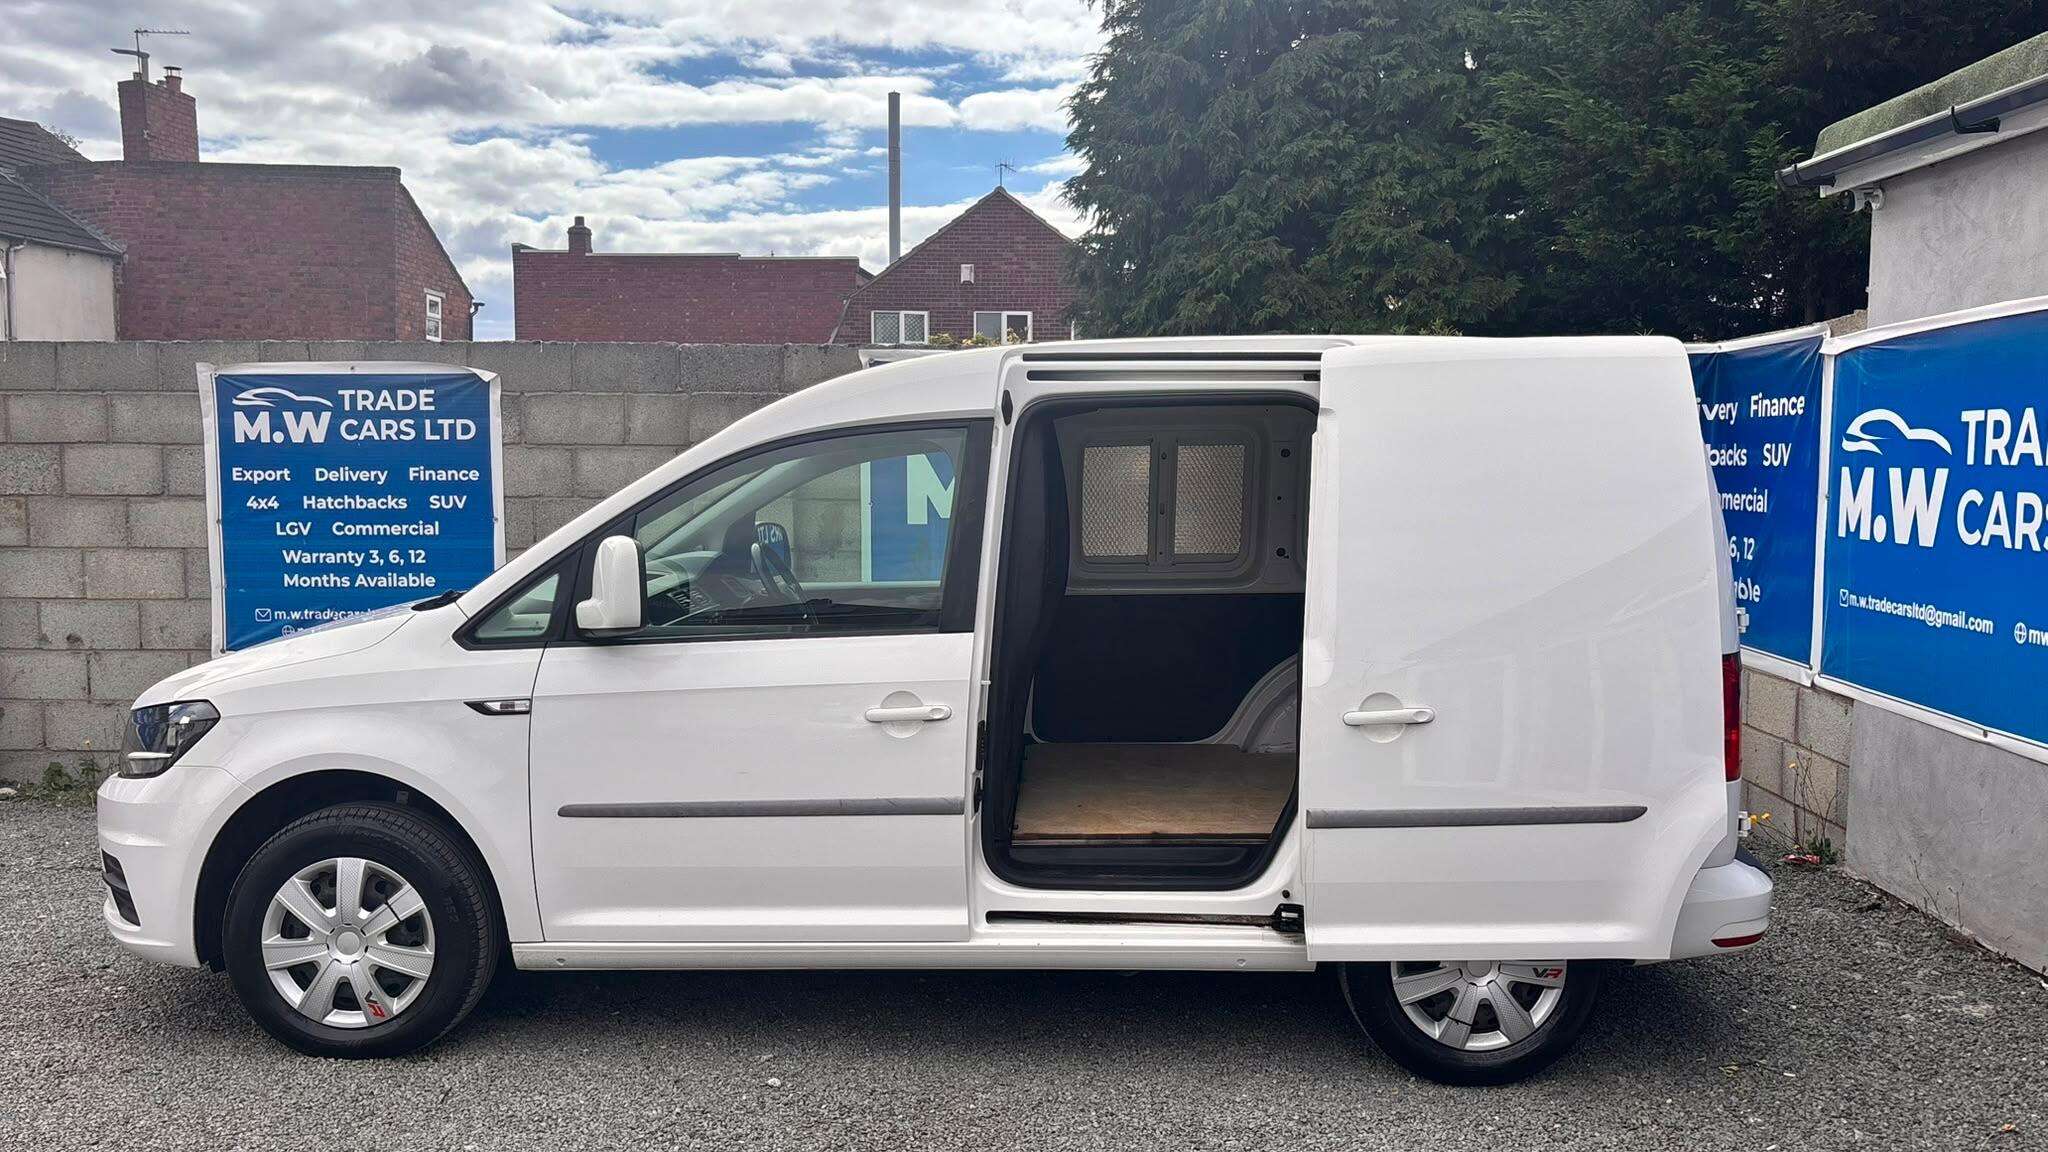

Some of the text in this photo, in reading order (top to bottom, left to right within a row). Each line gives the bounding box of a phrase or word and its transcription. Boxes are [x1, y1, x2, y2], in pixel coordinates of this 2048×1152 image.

[338, 389, 435, 411] TRADE
[1750, 392, 1805, 418] Finance
[234, 411, 332, 443] M.W
[340, 418, 477, 441] CARS LTD
[1960, 407, 2048, 466] TRA
[1762, 443, 1792, 467] SUV
[232, 466, 480, 485] Export Delivery Finance
[246, 495, 467, 510] 4x4 Hatchbacks SUV
[1719, 487, 1768, 513] mercial
[1837, 466, 1950, 548] M.W
[276, 521, 439, 536] LGV Commercial
[282, 550, 426, 567] Warranty 3, 6, 12
[1743, 537, 1755, 561] 12
[283, 573, 436, 588] Months Available
[1849, 593, 1993, 634] m.w.tradecarsltd@gmail.com
[1532, 967, 1563, 979] VR
